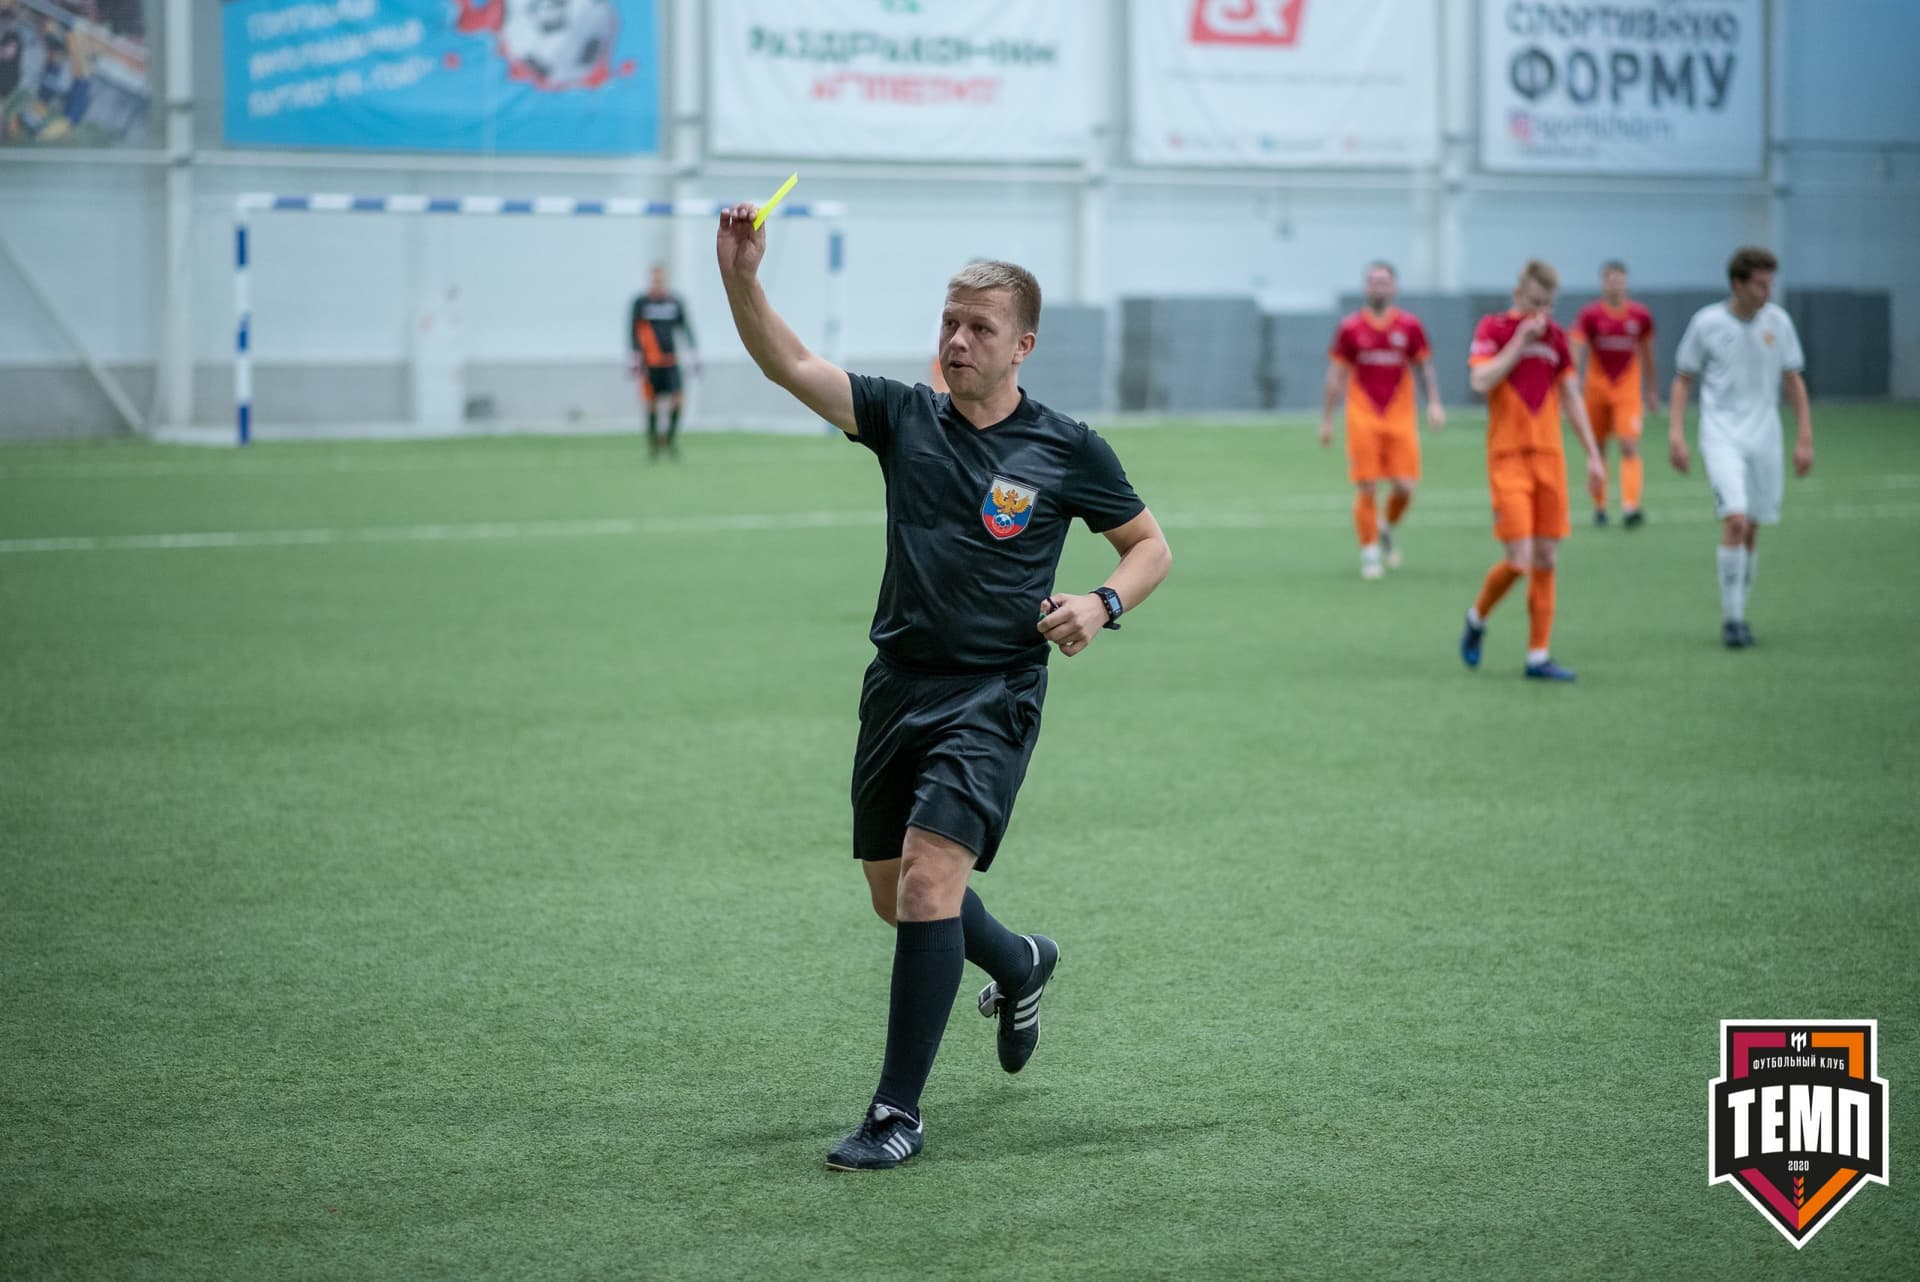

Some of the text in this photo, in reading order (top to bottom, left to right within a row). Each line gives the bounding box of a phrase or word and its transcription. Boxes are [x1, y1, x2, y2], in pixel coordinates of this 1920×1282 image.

[1506, 2, 1740, 42] СПОРТИВНУЮ
[811, 71, 1000, 104] АППЕТИТ
[1510, 48, 1736, 109] ФОРМУ
